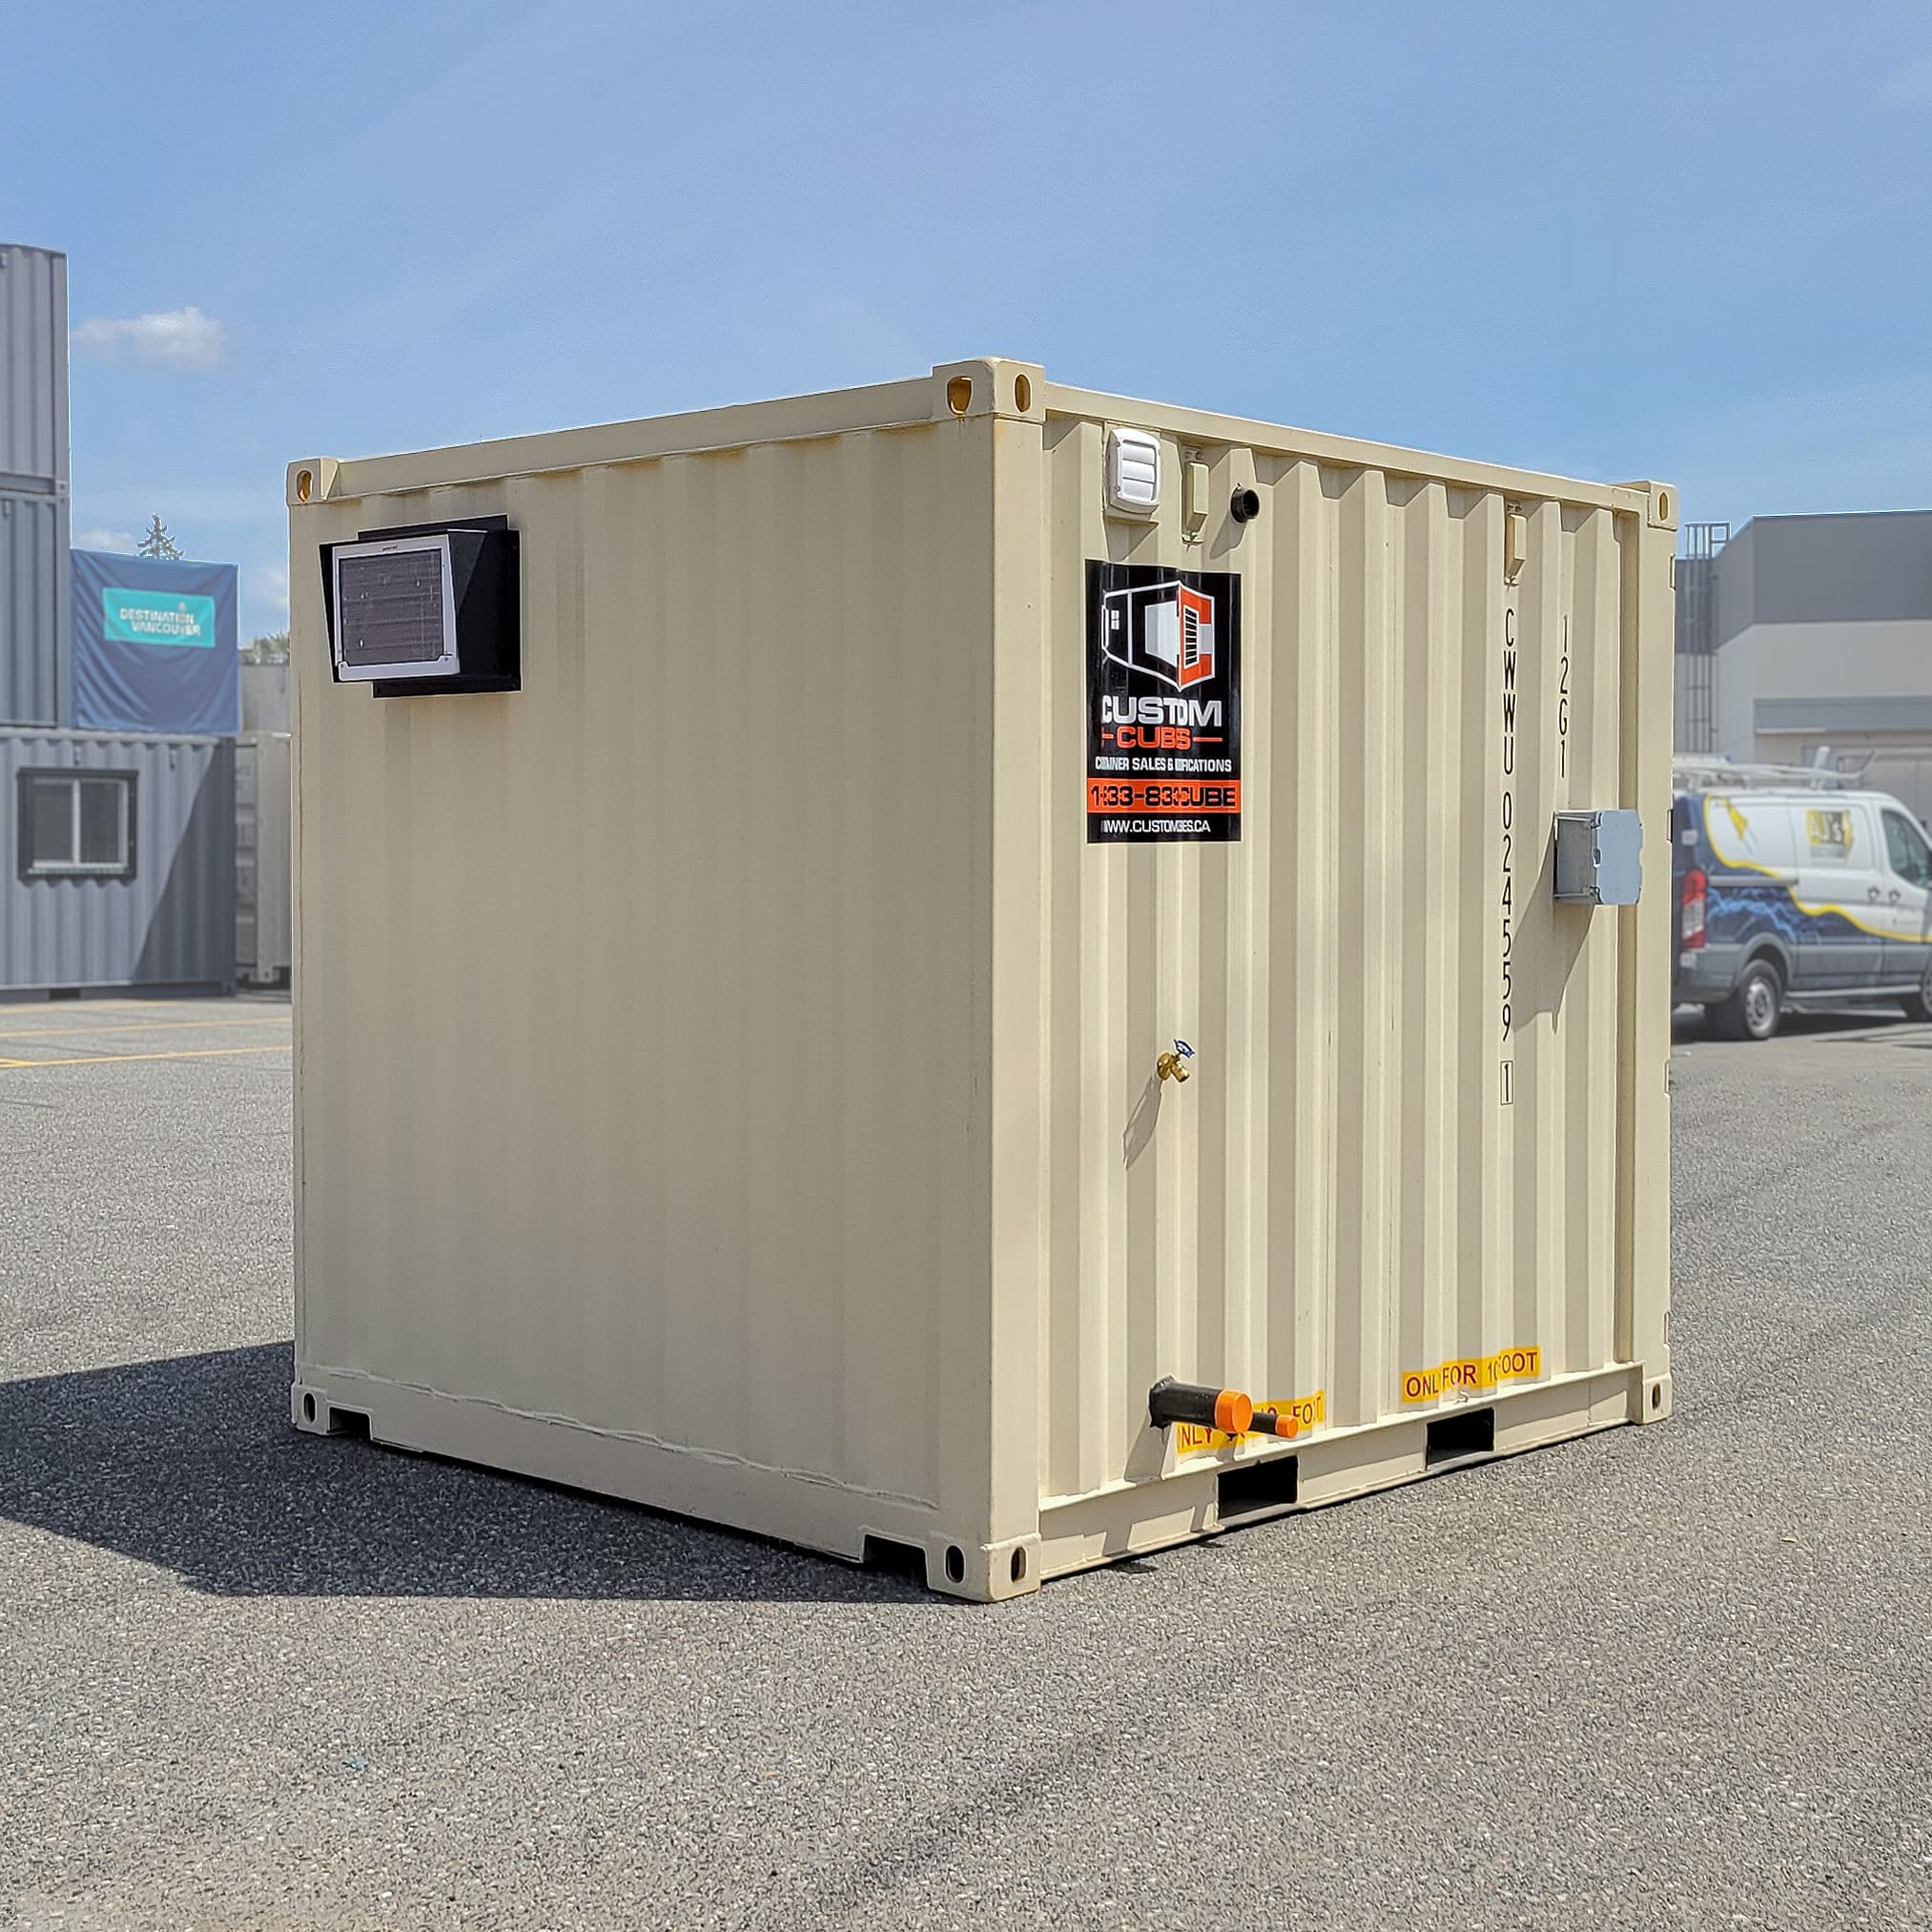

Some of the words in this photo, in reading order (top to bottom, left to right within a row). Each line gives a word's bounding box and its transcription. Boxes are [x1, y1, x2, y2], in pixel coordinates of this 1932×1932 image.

[1100, 695, 1223, 727] CUSTOM
[1503, 607, 1516, 775] CWWU
[1559, 614, 1569, 778] 12G1
[1132, 757, 1167, 771] SALES
[1502, 791, 1512, 1042] 024559
[1406, 1373, 1441, 1398] ONL
[1442, 1364, 1477, 1388] FOR
[1498, 1351, 1538, 1375] OOT
[1179, 1425, 1213, 1449] NLY
